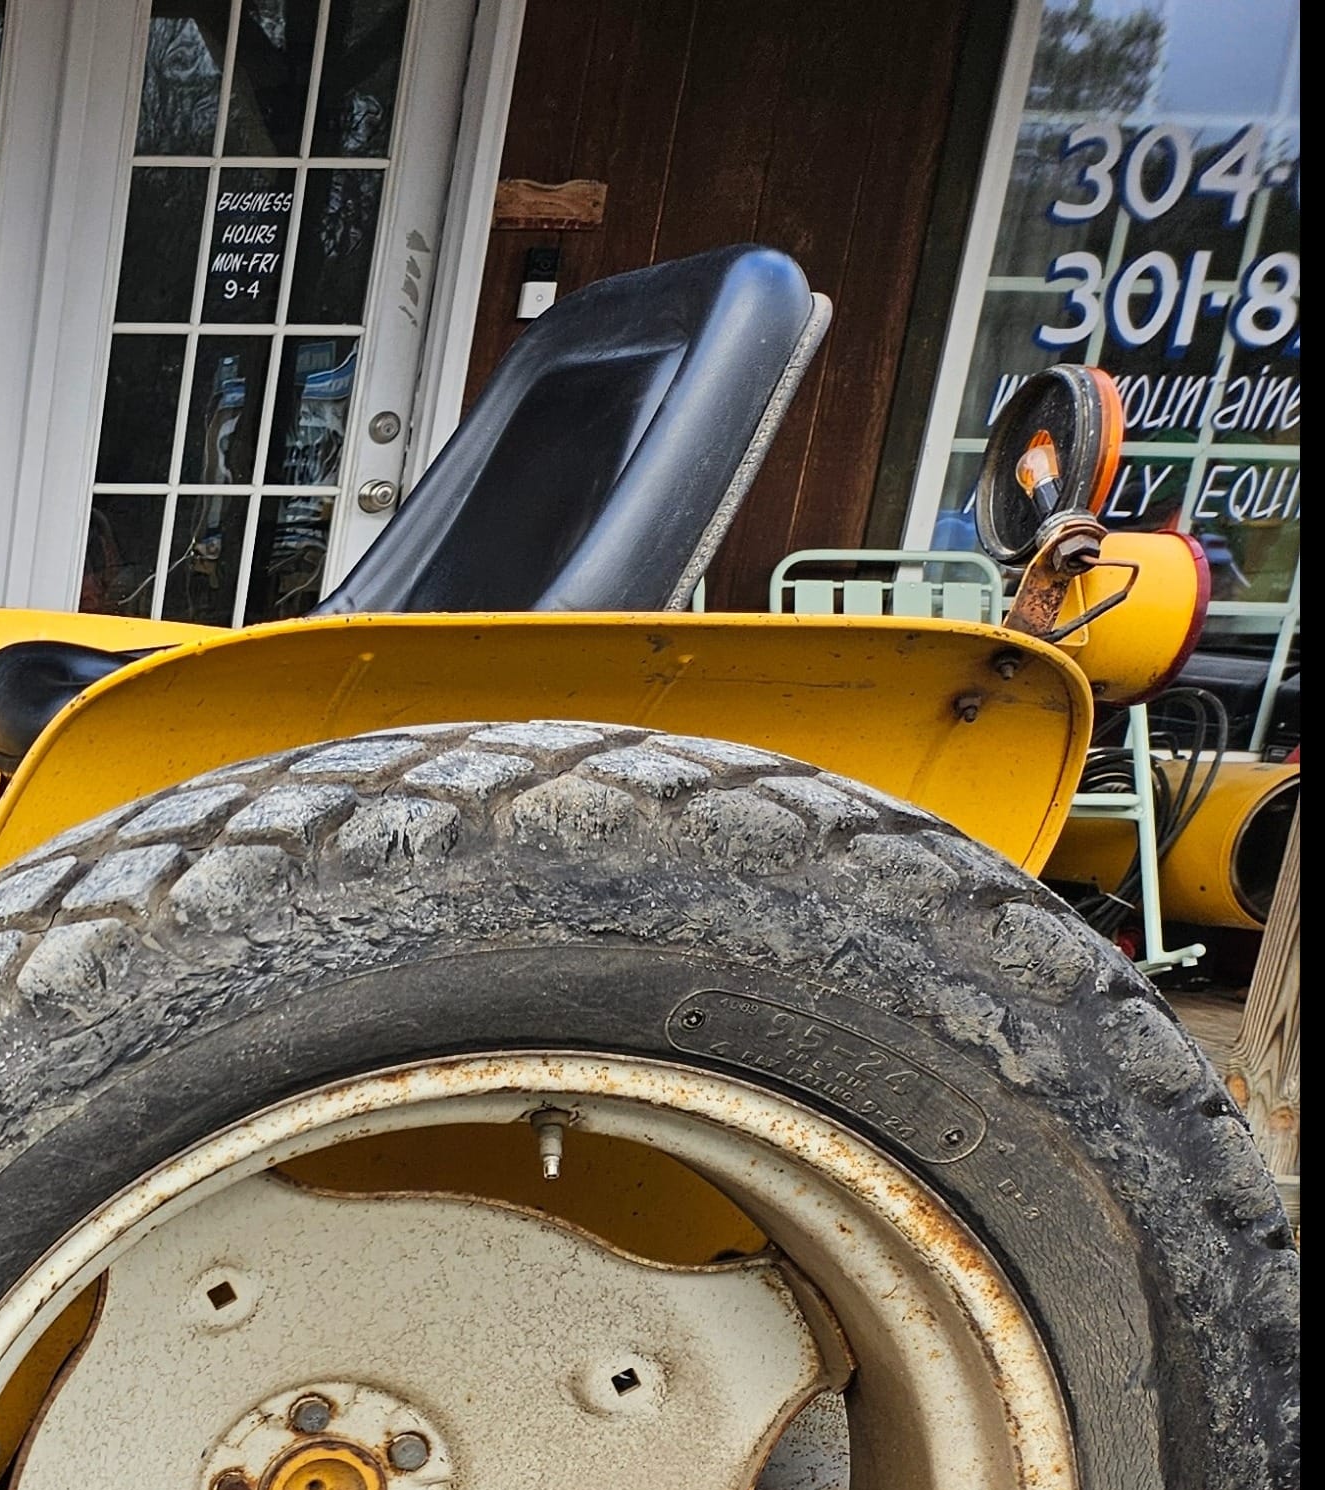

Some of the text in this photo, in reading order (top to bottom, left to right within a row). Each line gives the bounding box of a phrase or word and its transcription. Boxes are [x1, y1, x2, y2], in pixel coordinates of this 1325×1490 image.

[1049, 120, 1300, 223] 304-
[217, 192, 293, 212] BUSINESS
[221, 224, 278, 244] HOURS
[211, 252, 280, 273] MON-FRI
[223, 279, 260, 299] 9-4
[1033, 249, 1300, 350] 301-8
[1195, 465, 1300, 522] EQUI
